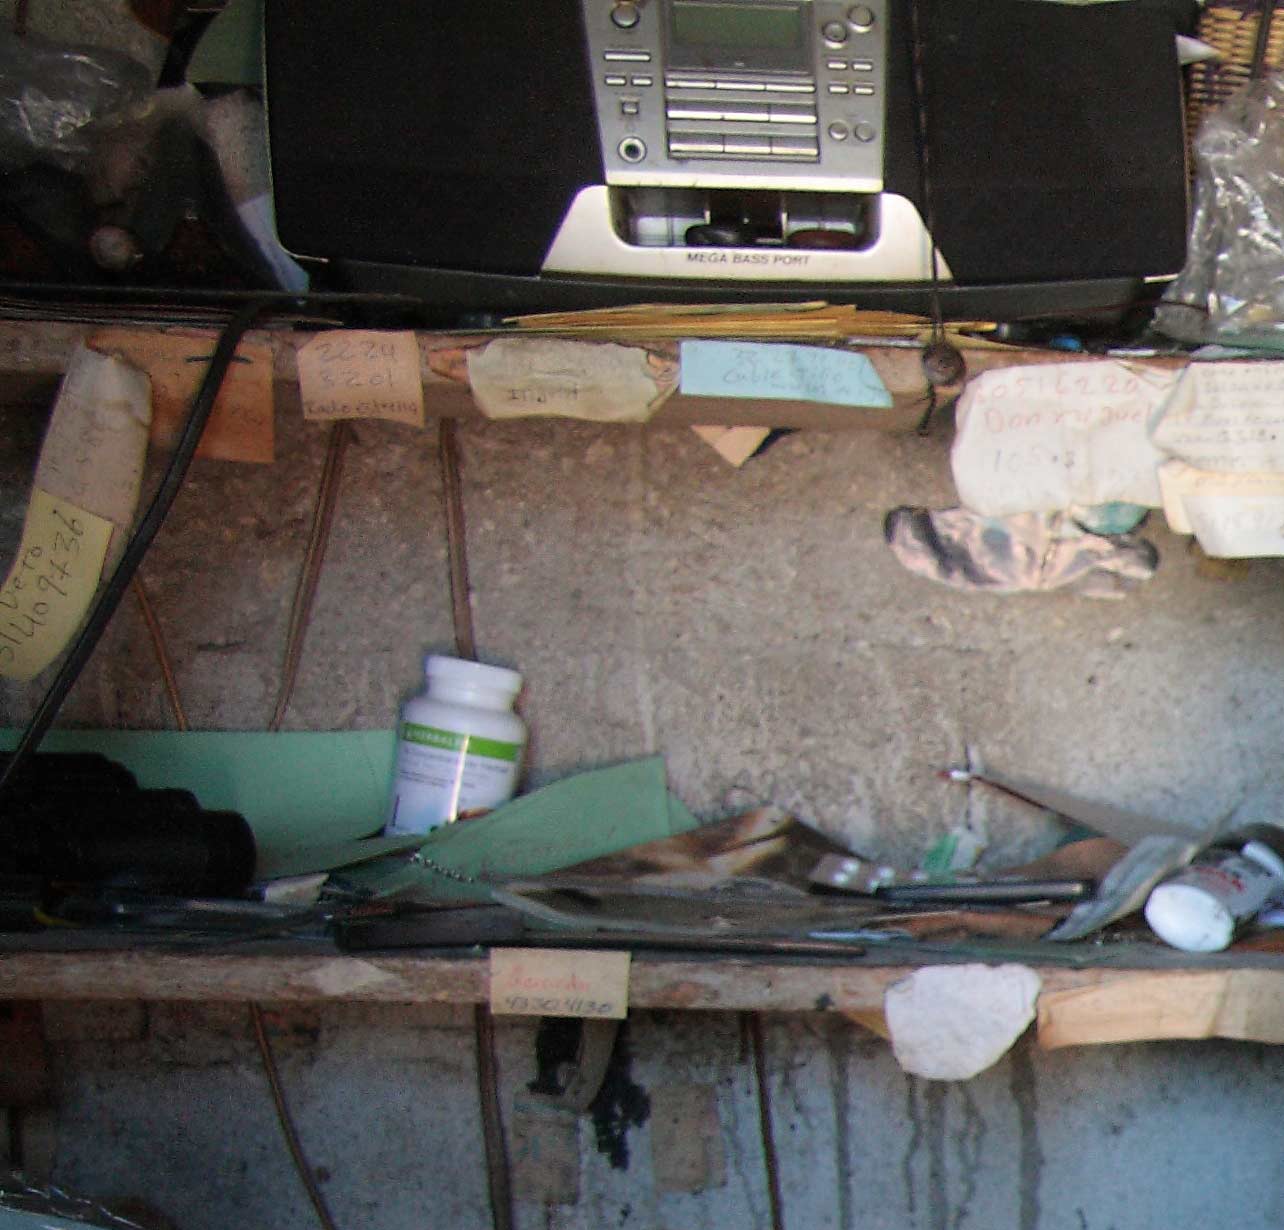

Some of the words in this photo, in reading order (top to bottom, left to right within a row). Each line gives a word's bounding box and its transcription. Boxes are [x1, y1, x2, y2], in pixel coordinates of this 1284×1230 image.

[686, 252, 728, 264] MEGA
[732, 253, 769, 265] BASS
[773, 254, 811, 266] PORT
